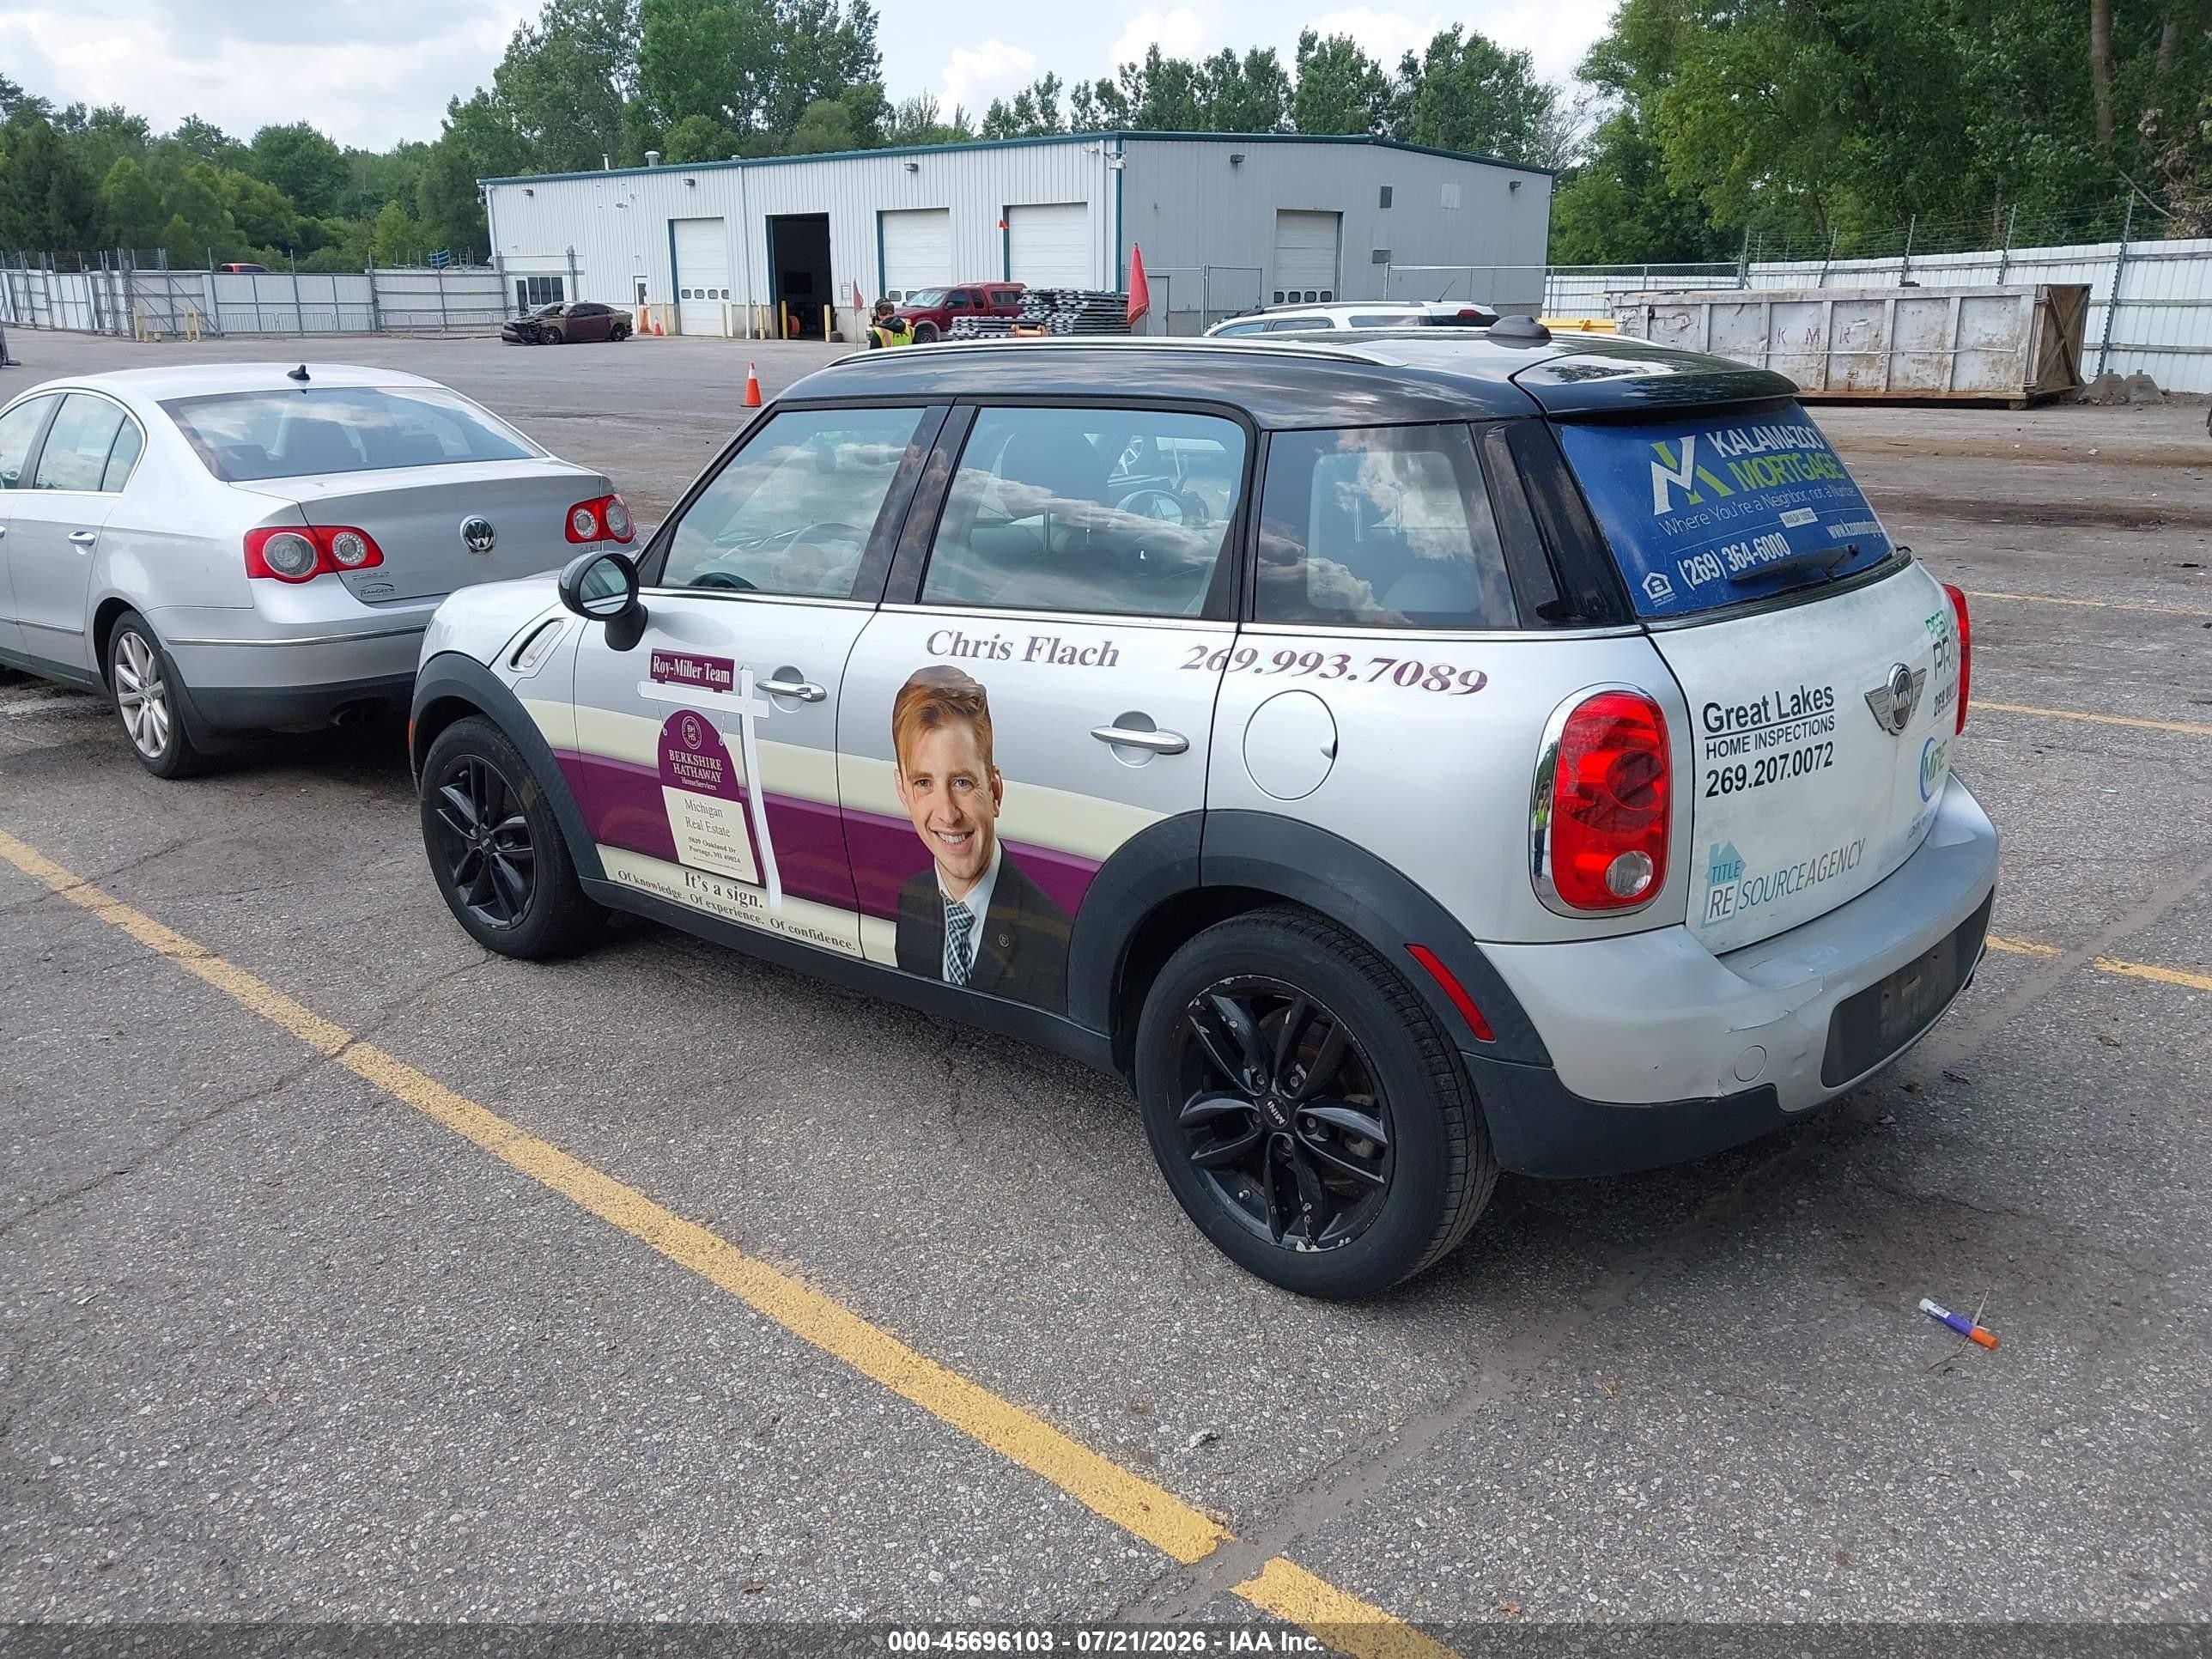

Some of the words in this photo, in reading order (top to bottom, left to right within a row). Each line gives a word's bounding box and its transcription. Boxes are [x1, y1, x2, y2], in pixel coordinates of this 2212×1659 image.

[1705, 426, 1825, 458] KALAMAZOO
[1727, 453, 1845, 491] MORTGAGE
[1659, 513, 1711, 536] Where
[1707, 501, 1753, 521] You're
[1753, 501, 1764, 511] a
[1760, 489, 1810, 509] Neighbor,
[1678, 549, 1727, 591] (269)
[1722, 532, 1791, 573] 364-6000
[926, 629, 1013, 661] Chris
[1023, 635, 1120, 667] Flach
[653, 655, 702, 679] Roy-Miller
[704, 662, 730, 684] Team
[1178, 645, 1488, 696] 269.993.7089
[1703, 695, 1770, 732] Great
[1775, 684, 1834, 720] Lakes
[1705, 738, 1751, 760] HOME
[1754, 714, 1835, 750] INSPECTIONS
[668, 750, 722, 771] BERKSHIRE
[673, 763, 722, 782] HATHAWAY
[1705, 741, 1834, 798] 269.207.0072
[681, 776, 716, 790] HomeServices
[684, 798, 723, 818] Michigan
[685, 817, 703, 831] Real
[704, 820, 731, 838] Estate
[702, 840, 727, 851] Oakland
[1712, 860, 1741, 883] TITLE
[684, 871, 708, 892] It's
[713, 883, 722, 896] a
[726, 885, 763, 909] sign.
[618, 869, 632, 882] Of
[634, 874, 685, 901] knowledge.
[690, 894, 703, 906] Of
[706, 900, 764, 926] experience.
[770, 917, 785, 930] Of
[788, 920, 856, 951] confidence.
[1267, 1100, 1285, 1125] MINI
